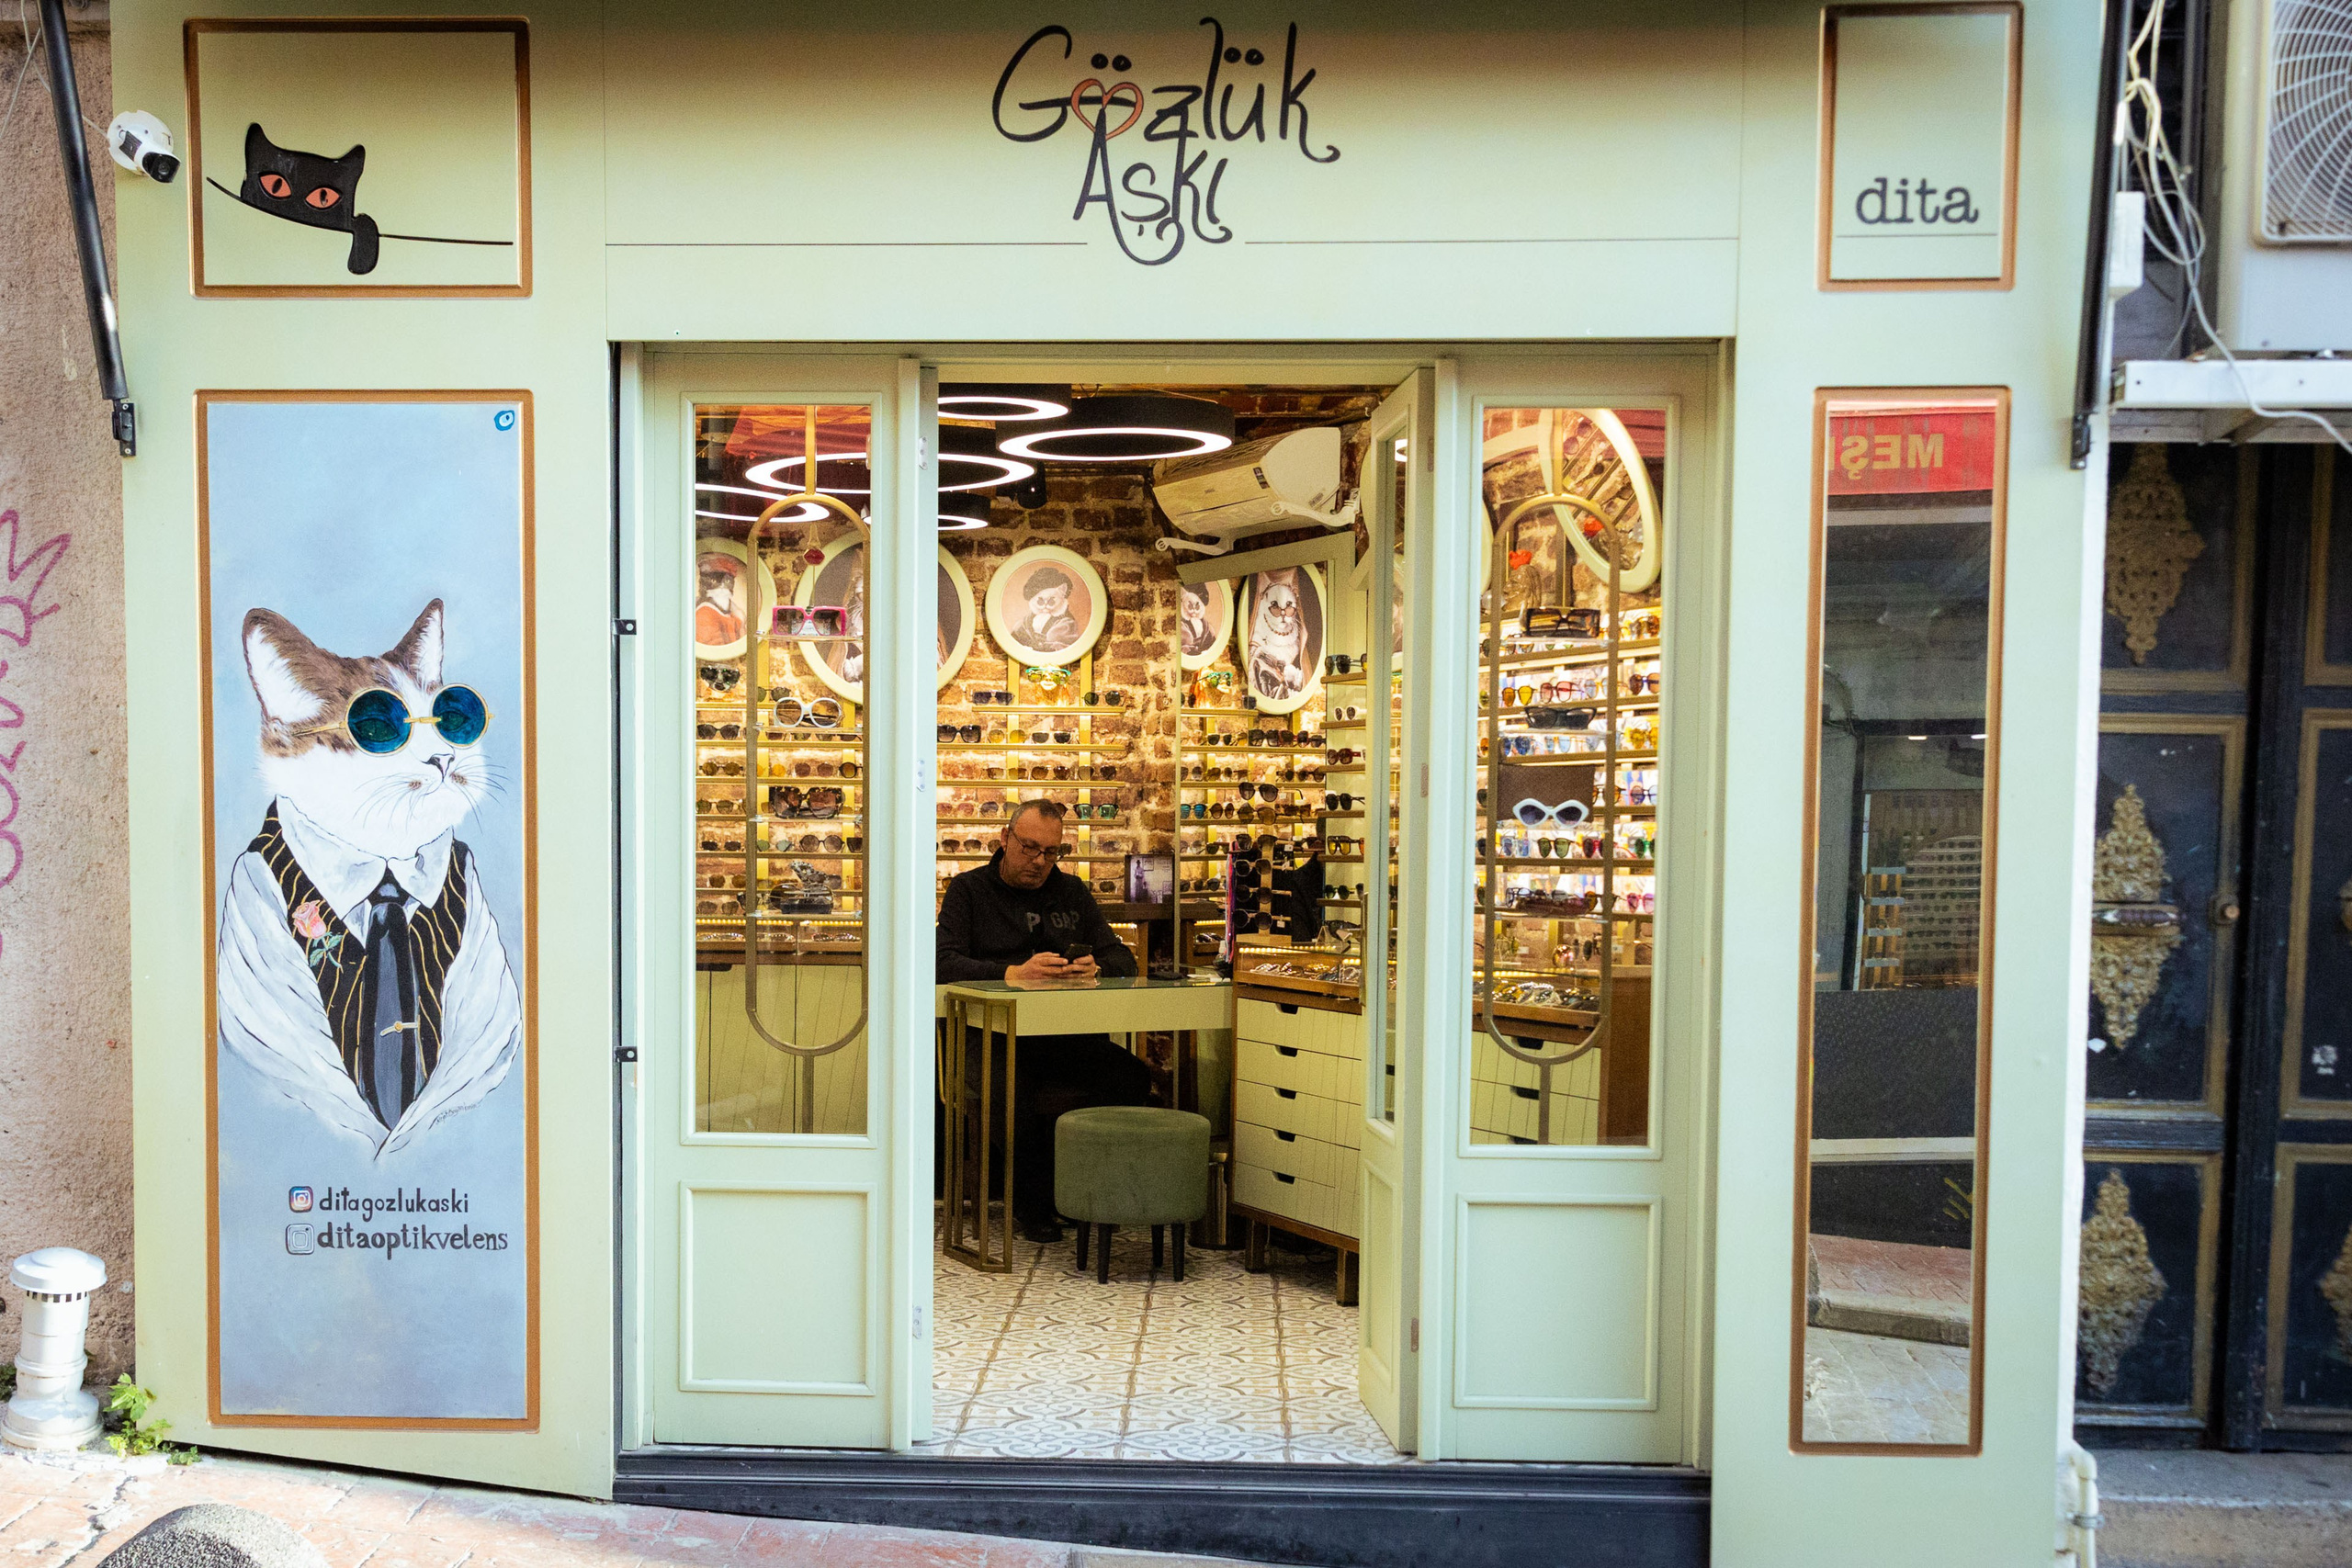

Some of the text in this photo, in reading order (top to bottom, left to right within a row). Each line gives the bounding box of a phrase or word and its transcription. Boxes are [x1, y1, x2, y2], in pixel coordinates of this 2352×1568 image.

[991, 17, 1341, 164] Gözlük
[1855, 176, 1979, 227] dita
[318, 1186, 469, 1223] ditagozlukaski
[316, 1221, 509, 1261] ditaoptikvelens
